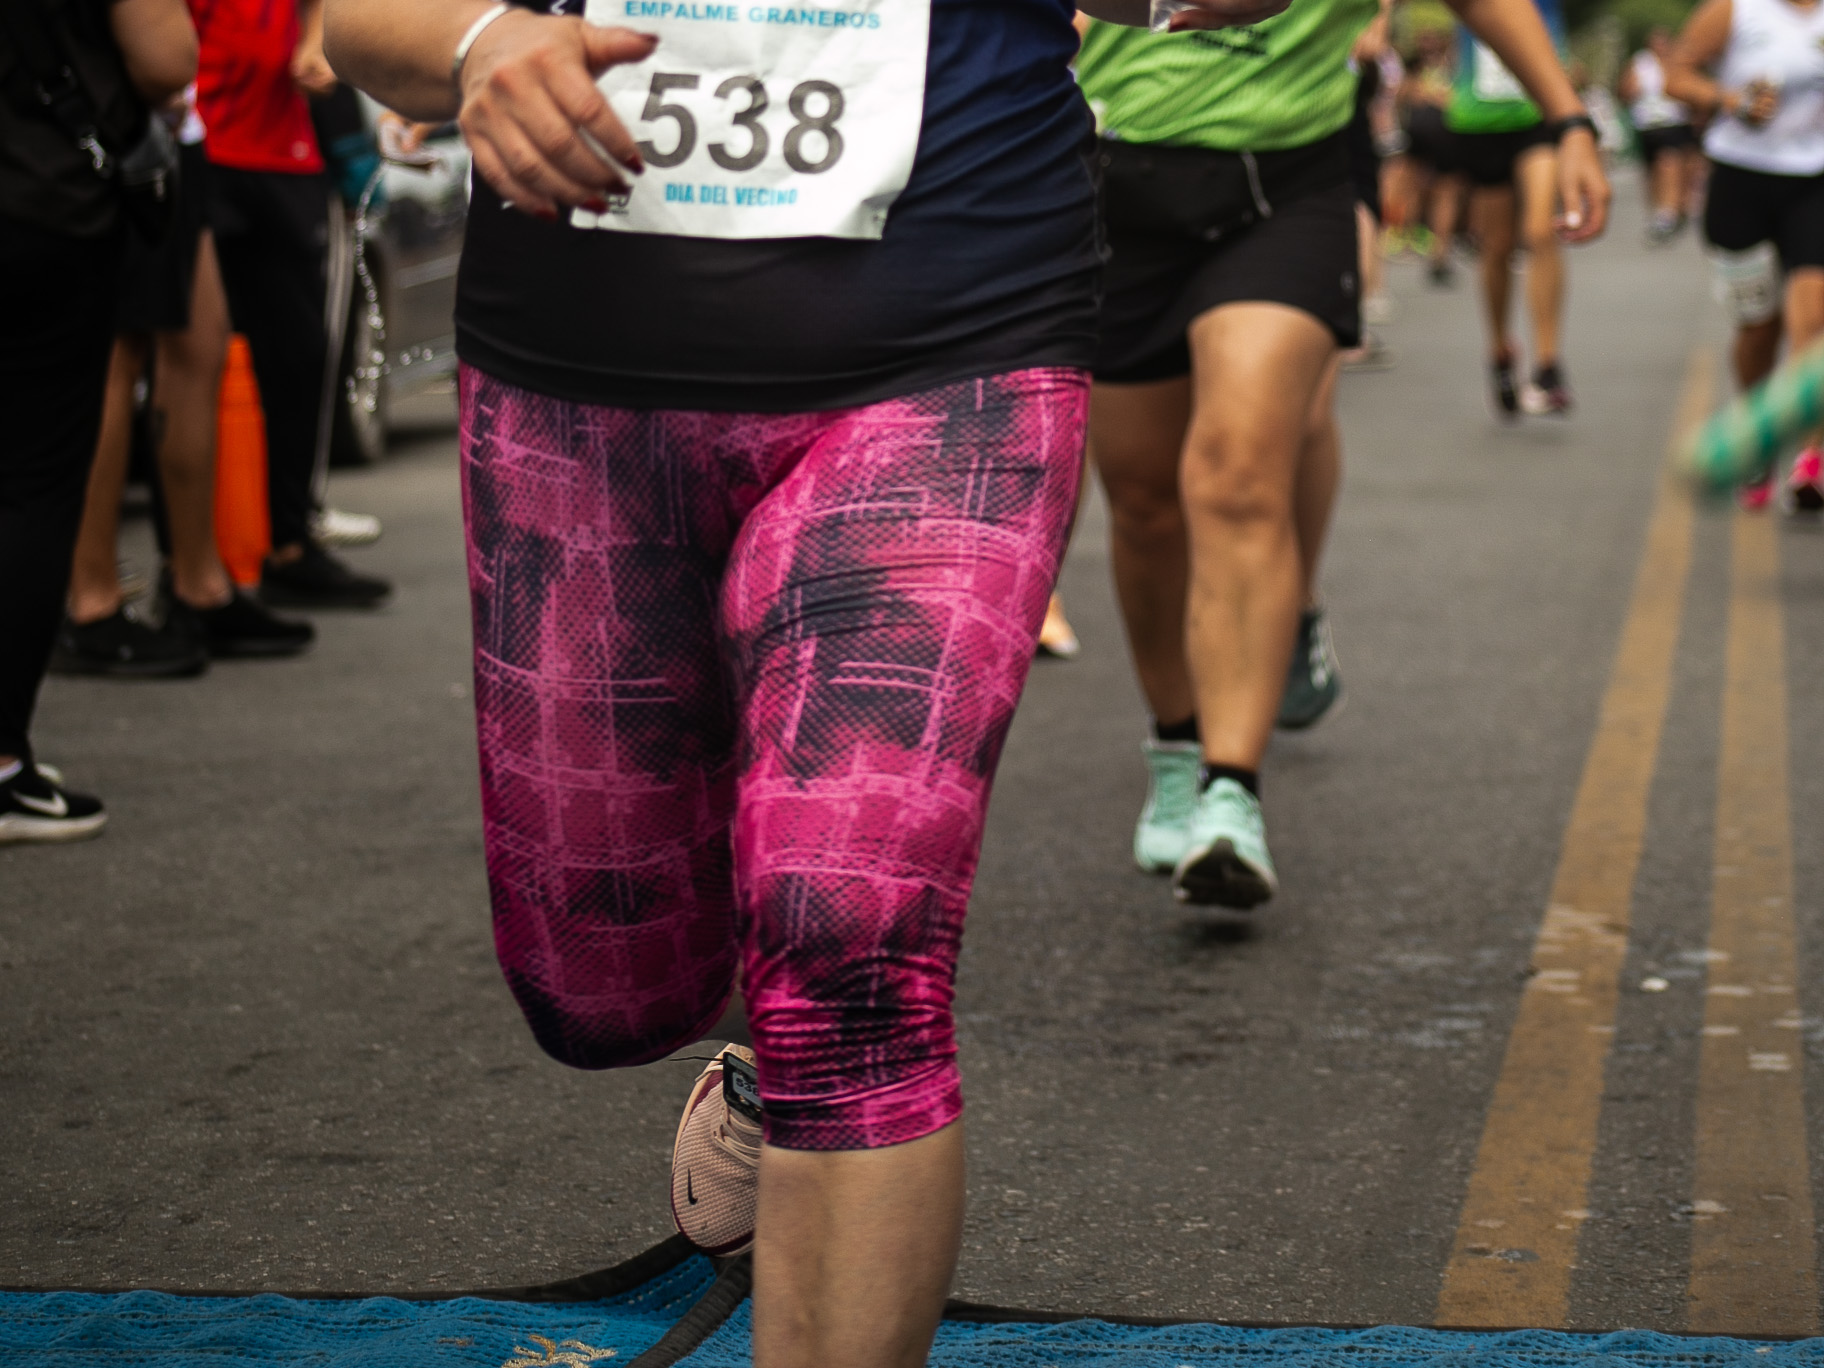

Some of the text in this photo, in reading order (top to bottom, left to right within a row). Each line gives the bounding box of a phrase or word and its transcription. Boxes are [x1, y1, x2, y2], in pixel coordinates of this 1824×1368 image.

[625, 0, 882, 30] EMPALME GRANEROS
[635, 72, 845, 175] 538
[665, 183, 798, 207] DIA DEL VECINO
